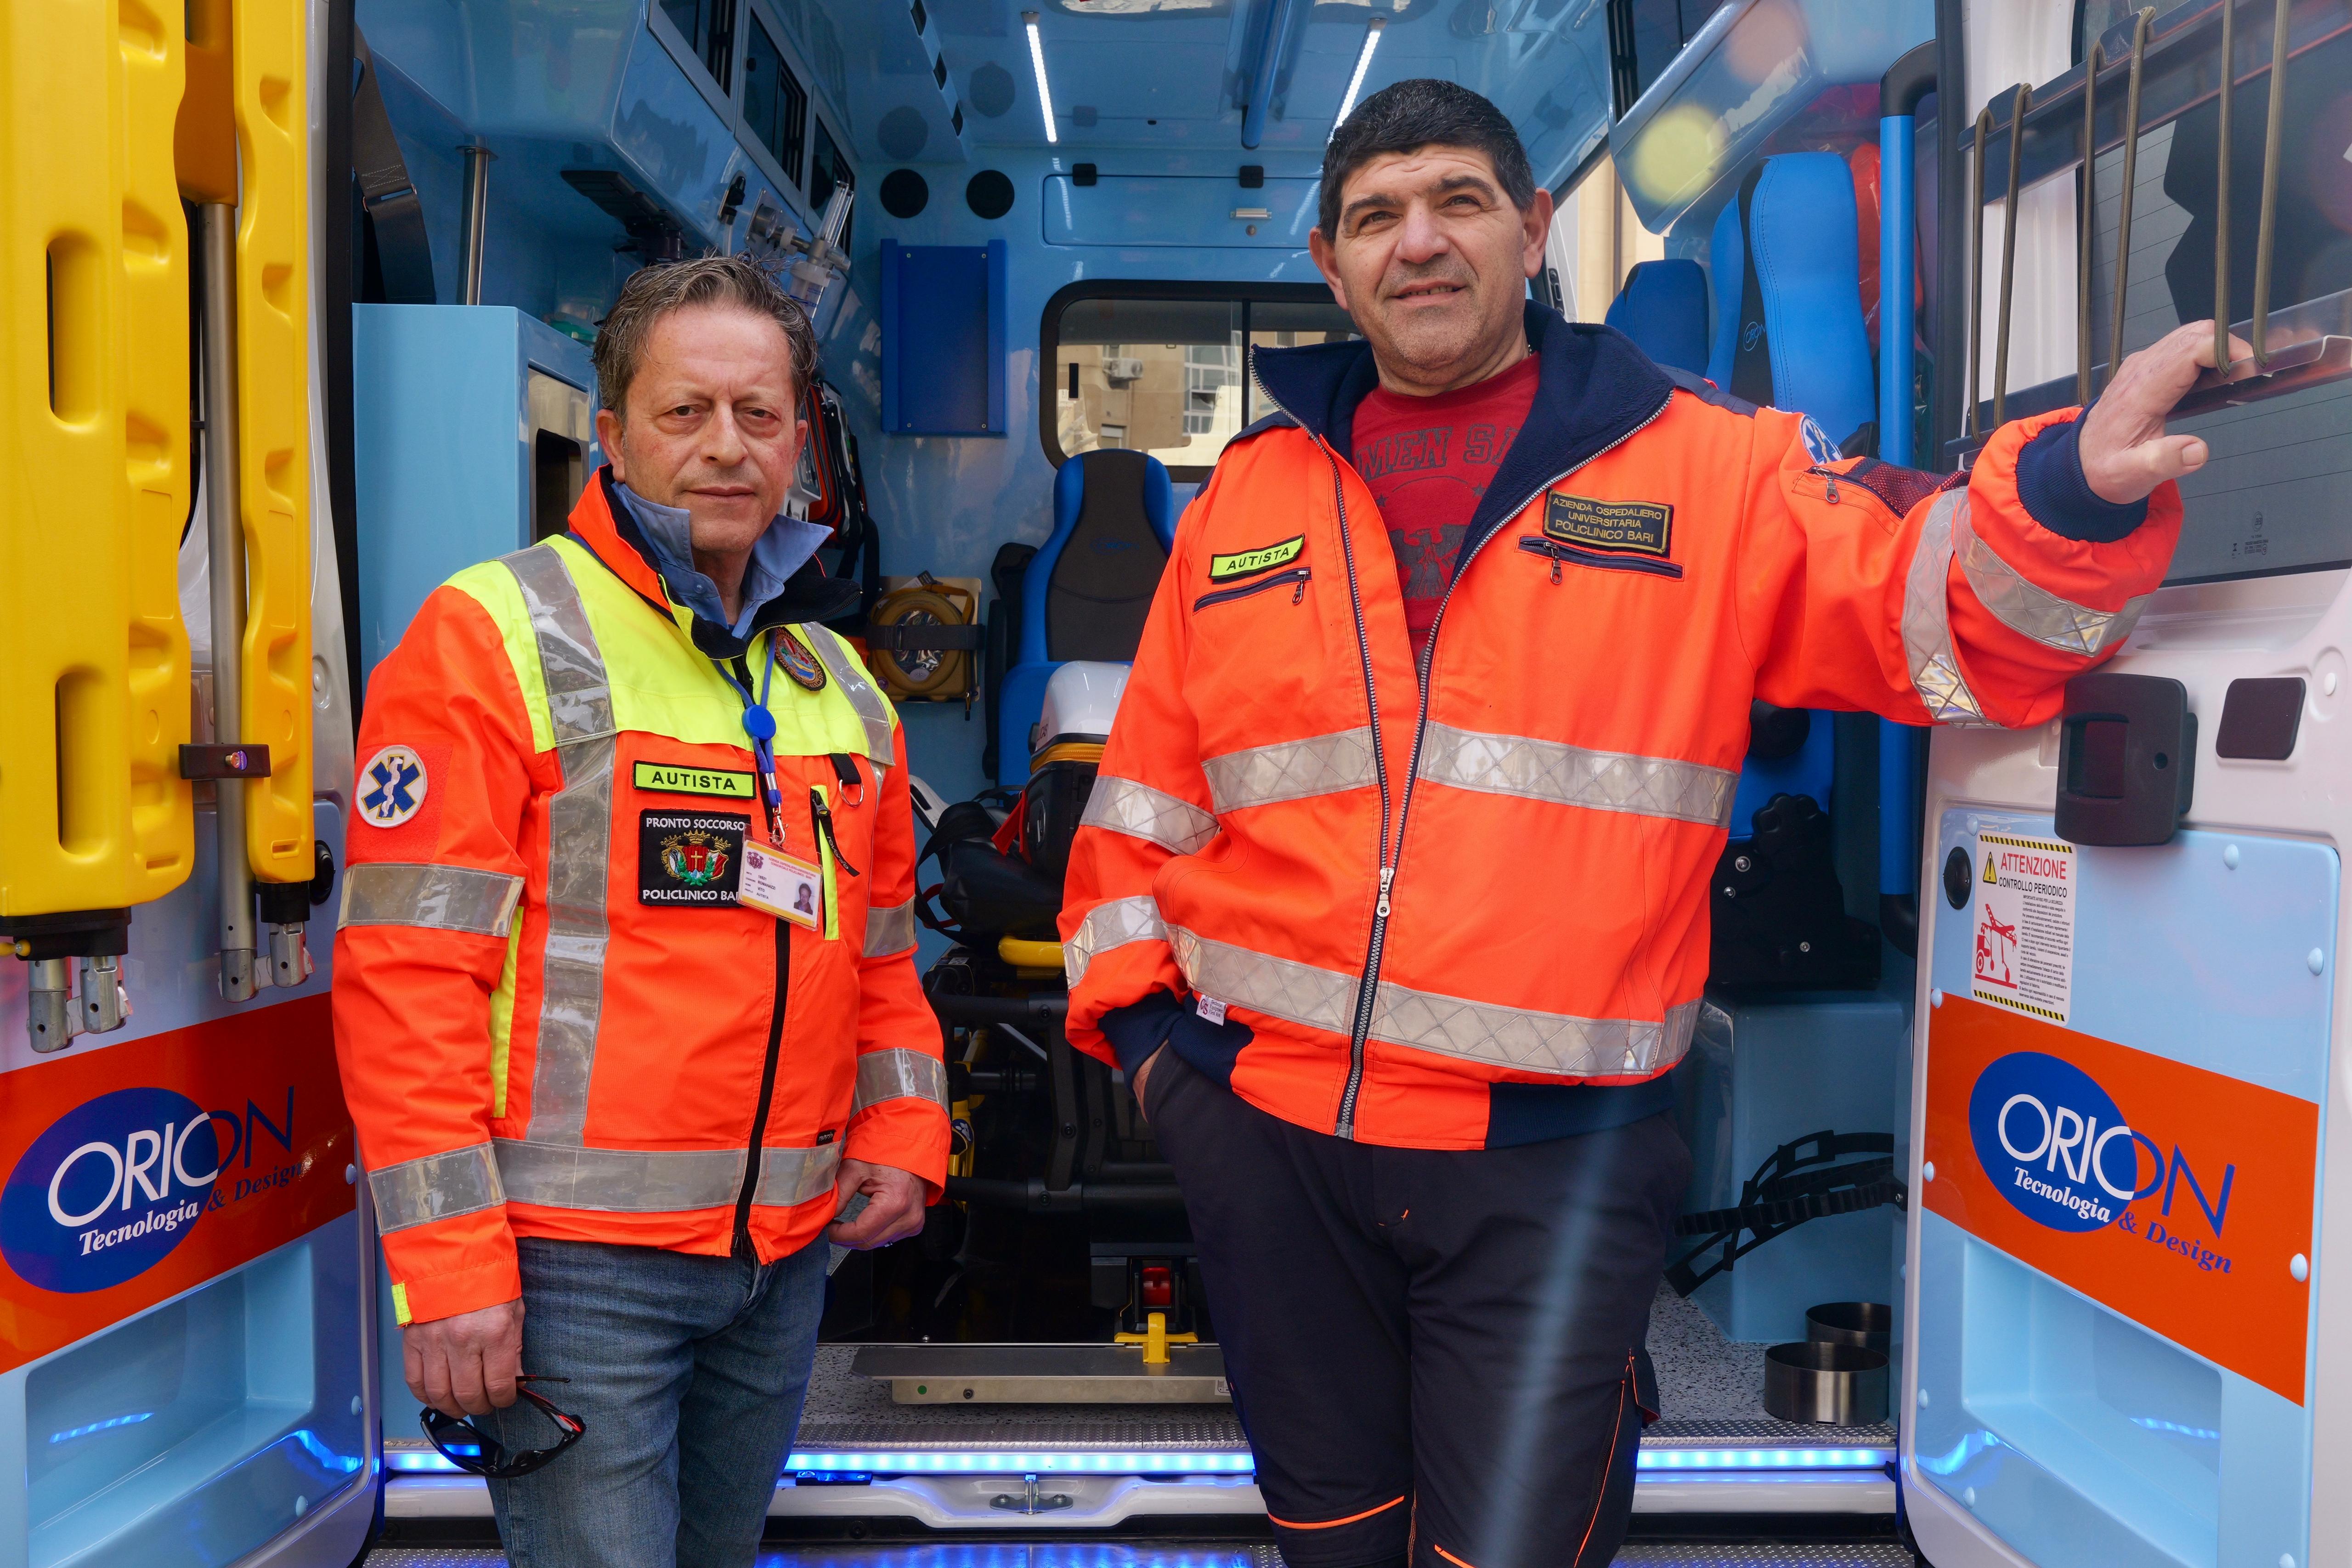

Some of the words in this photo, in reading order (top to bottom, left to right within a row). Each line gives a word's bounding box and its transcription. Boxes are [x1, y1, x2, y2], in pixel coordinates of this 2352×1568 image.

[1553, 498, 1593, 512] AZIENDA
[1596, 506, 1662, 520] OSPEDALIERO
[1568, 511, 1642, 528] UNIVERSITARIA
[1555, 519, 1623, 540] POLICLINICO
[1628, 530, 1654, 543] BARI
[1226, 547, 1289, 571] AUTISTA
[651, 771, 736, 791] AUTISTA
[646, 817, 691, 829] PRONTO
[693, 819, 746, 831] SOCCORSO
[2000, 852, 2067, 880] ATTENZIONE
[643, 889, 718, 900] POLICLINICO
[1999, 877, 2033, 892] CONTROLLO
[2034, 882, 2068, 898] PERIODICO
[47, 1085, 294, 1227] ORION
[1998, 1093, 2236, 1240] ORION
[79, 1199, 199, 1256] Tecnologia
[206, 1189, 226, 1212] &
[232, 1162, 302, 1203] Design
[2014, 1166, 2111, 1223] Tecnologia
[2118, 1211, 2138, 1235] &
[2144, 1220, 2232, 1274] Design
